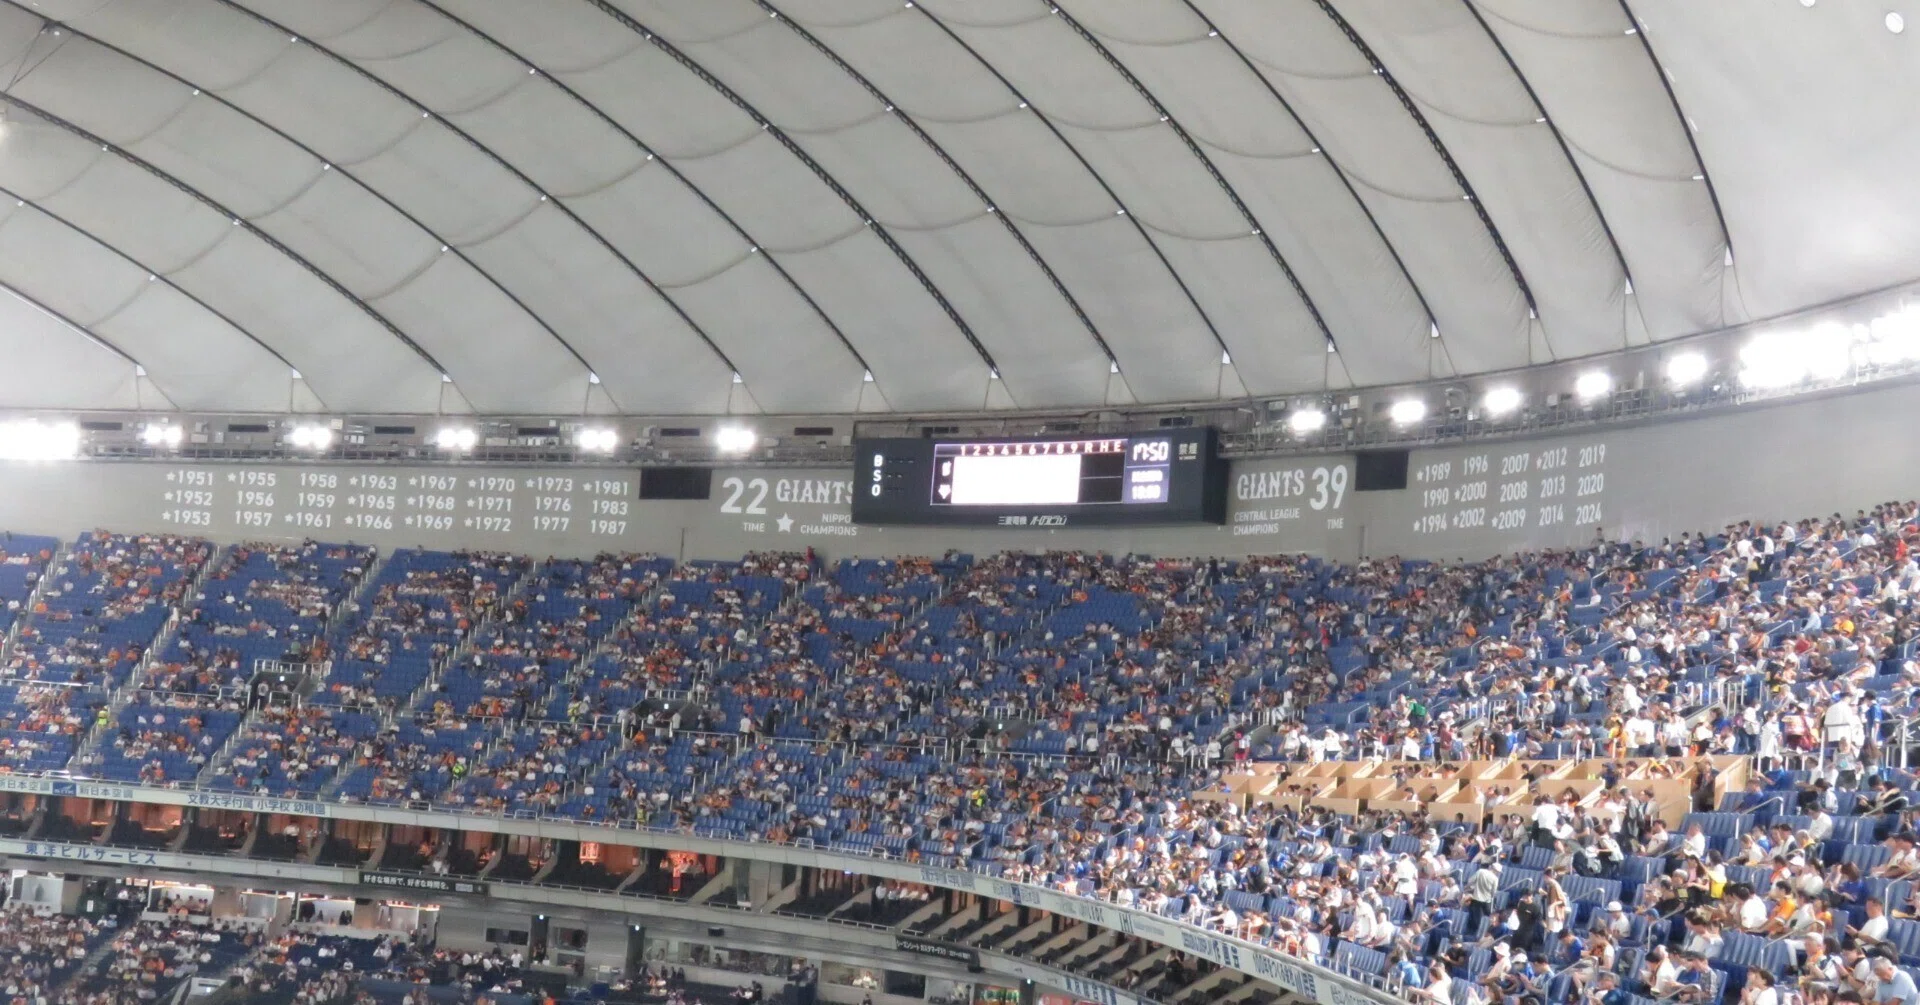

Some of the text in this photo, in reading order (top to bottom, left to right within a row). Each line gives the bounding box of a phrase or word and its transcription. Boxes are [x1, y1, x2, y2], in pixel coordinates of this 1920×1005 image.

[874, 454, 883, 467] B
[1132, 442, 1169, 461] 17:50
[1424, 444, 1606, 481] 1989 1996 2007 2012 2019
[177, 470, 629, 496] 1951 1955 1958 1963 1967 1970 1973 1981
[873, 469, 882, 482] S
[720, 477, 768, 514] 22
[871, 484, 881, 496] O
[1237, 465, 1348, 510] GIANTS 39
[1424, 473, 1604, 508] 1990 2000 2008 2013 2020
[176, 490, 629, 516] 1952 1956 1959 1965 1968 1971 1976 1983
[174, 509, 627, 536] 1953 1957 1961 1966 1969 1972 1977 1987
[1234, 508, 1300, 522] CENTRAL LEAGUE
[1327, 518, 1344, 530] TIME
[1422, 502, 1603, 533] 1994 2002 2009 2014 2024
[744, 522, 765, 533] TIME
[800, 524, 858, 536] CHAMPIONS
[1233, 523, 1279, 536] CHAMPIONS
[257, 799, 291, 812] 小学校
[25, 843, 157, 865] 東洋ビルサービス
